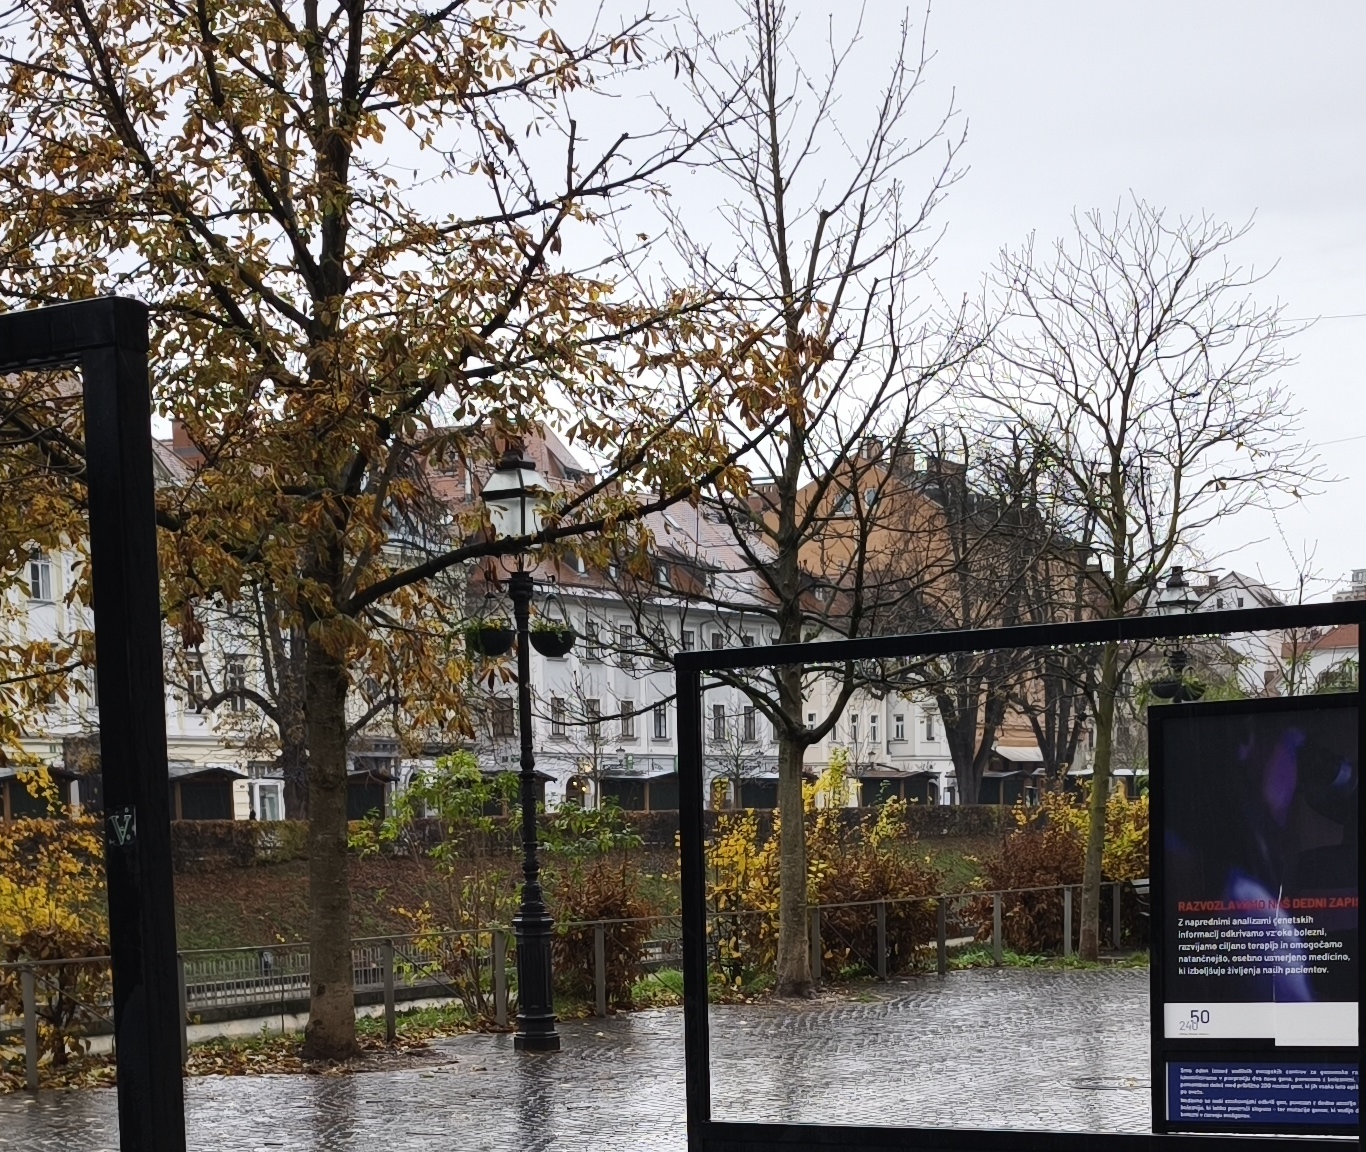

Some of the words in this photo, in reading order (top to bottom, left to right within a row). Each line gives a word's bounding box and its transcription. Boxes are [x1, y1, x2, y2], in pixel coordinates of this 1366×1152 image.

[1291, 897, 1328, 909] DEDNI
[1327, 897, 1358, 908] ZAPI
[1177, 918, 1183, 926] Z
[1184, 917, 1230, 927] naprednimi
[1231, 916, 1271, 925] analizami
[1178, 929, 1219, 939] informacij
[1293, 928, 1327, 936] bolezni,
[1308, 952, 1351, 960] medicino,
[1190, 1009, 1210, 1024] 50
[1178, 1020, 1199, 1031] 240
